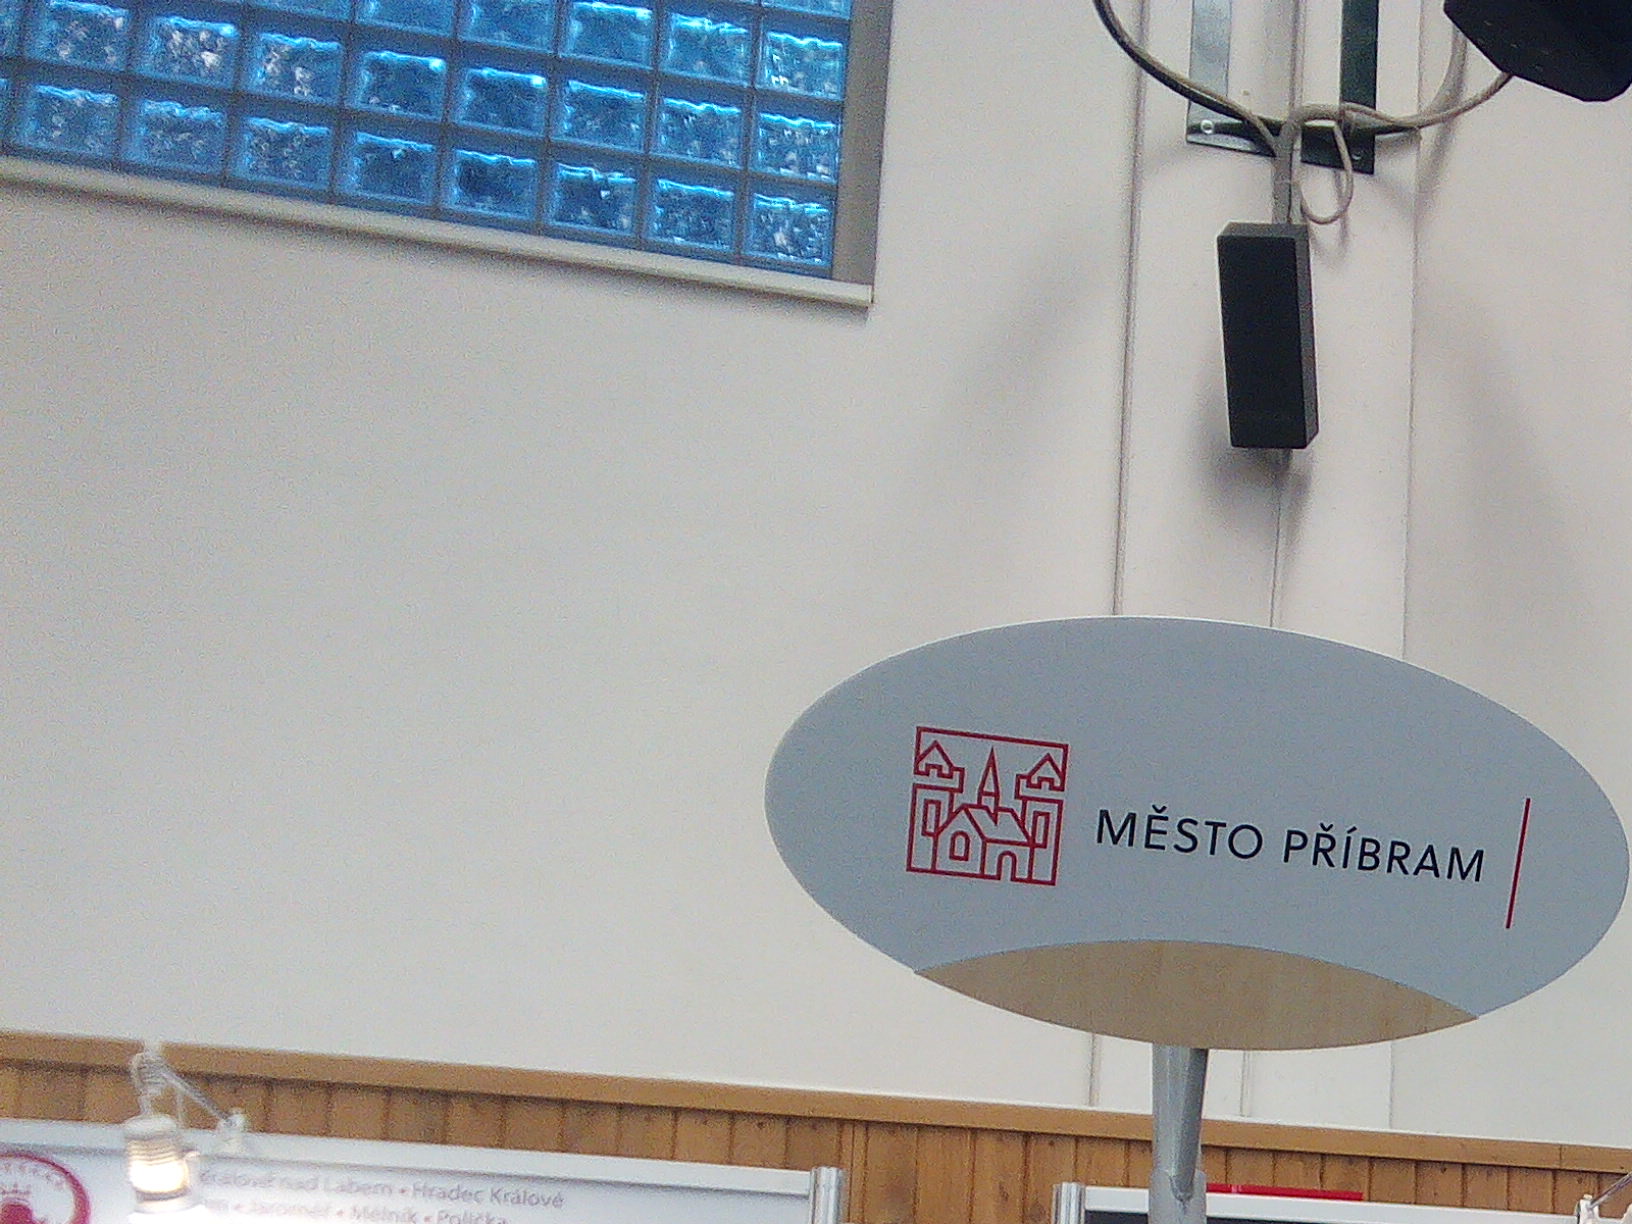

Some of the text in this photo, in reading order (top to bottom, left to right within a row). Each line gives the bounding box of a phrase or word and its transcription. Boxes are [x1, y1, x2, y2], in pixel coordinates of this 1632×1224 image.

[1096, 804, 1485, 883] MĚSTO PŘÍBRAM
[323, 1177, 394, 1195] Labem
[412, 1181, 485, 1203] Hradec
[490, 1186, 566, 1209] Králové
